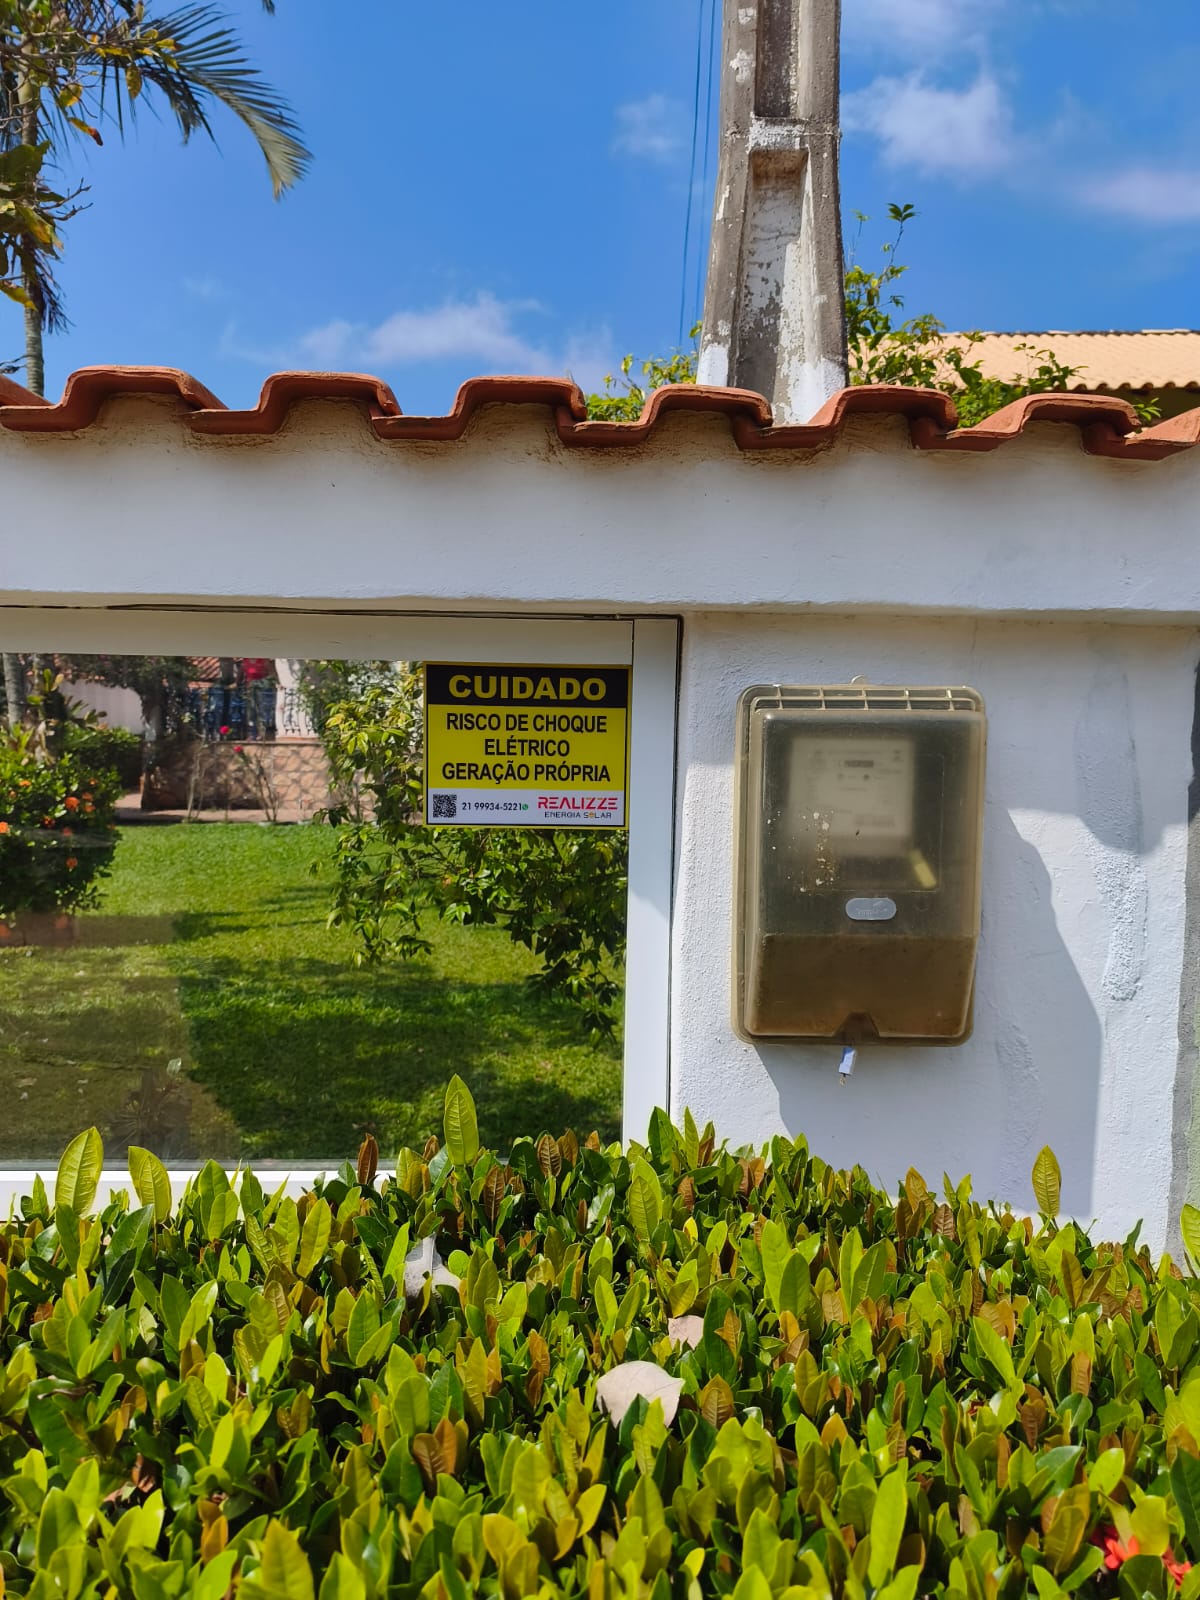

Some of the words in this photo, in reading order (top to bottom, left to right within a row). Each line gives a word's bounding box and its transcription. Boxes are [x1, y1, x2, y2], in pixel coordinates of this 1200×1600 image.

[448, 674, 607, 701] CUIDADO
[446, 713, 501, 731] RISCO
[505, 714, 529, 732] DE
[533, 714, 607, 733] CHOQUE
[484, 735, 570, 757] ELÉTRICO
[442, 760, 530, 784] GERAÇÃO
[534, 761, 611, 782] PRÓPRIA
[462, 802, 472, 811] 21
[474, 802, 523, 811] 99934-5221
[538, 796, 618, 810] REALIZZE
